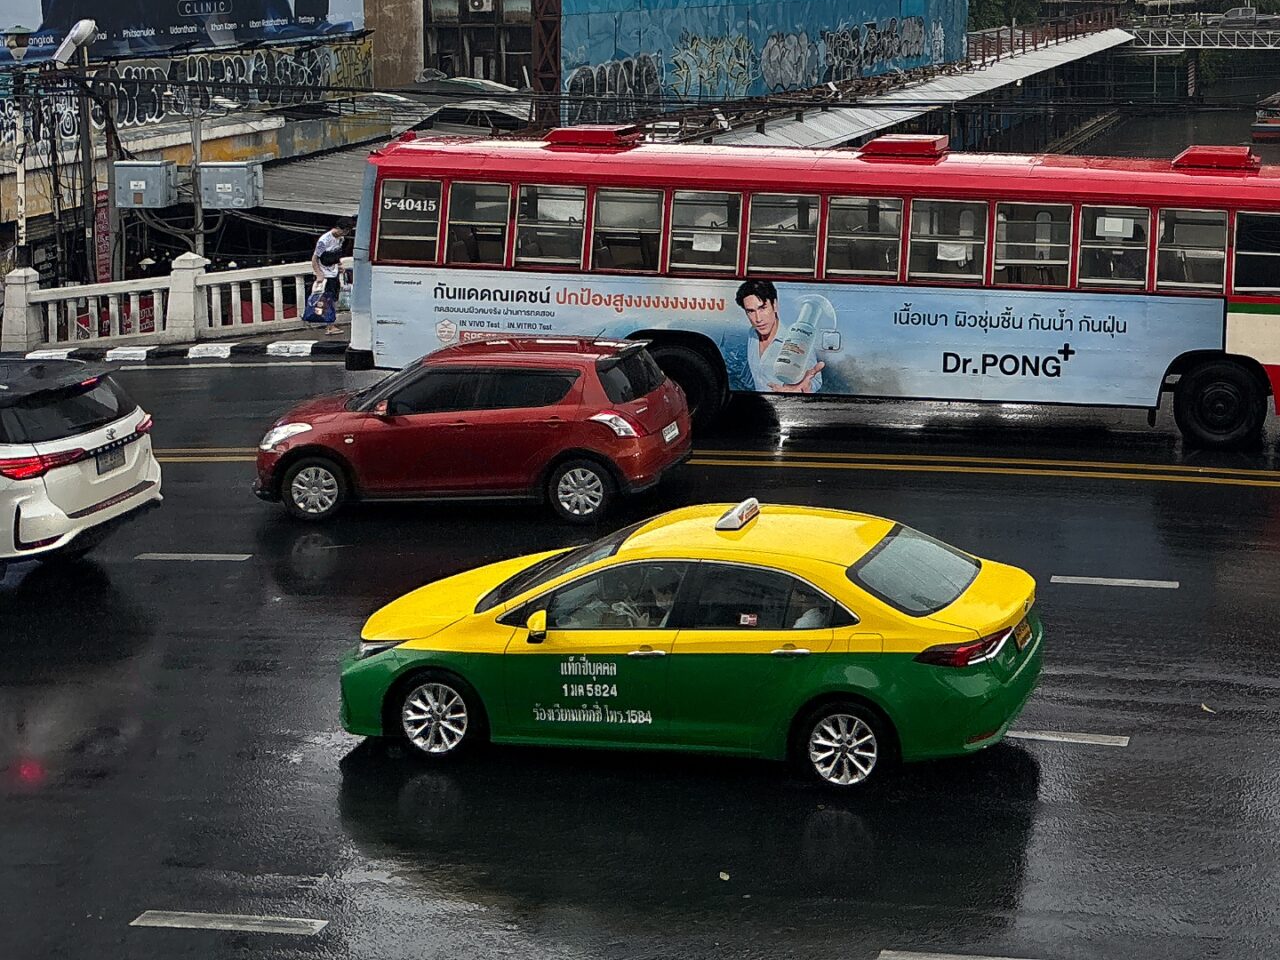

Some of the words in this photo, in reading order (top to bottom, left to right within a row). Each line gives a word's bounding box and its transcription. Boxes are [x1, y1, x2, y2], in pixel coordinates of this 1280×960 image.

[185, 1, 226, 14] CLINIC
[28, 35, 54, 47] angkok
[383, 198, 437, 212] 5-40415
[433, 282, 552, 305] กันแดดณเดชน์
[469, 320, 485, 328] VIVO
[487, 321, 500, 329] Test
[893, 302, 949, 327] เนื้อเบา
[954, 306, 1023, 334] ผิวชุ่มชื้น
[1028, 309, 1074, 333] กันน้ำ
[1078, 314, 1128, 339] กันฝุ่น
[585, 683, 618, 697] 5824
